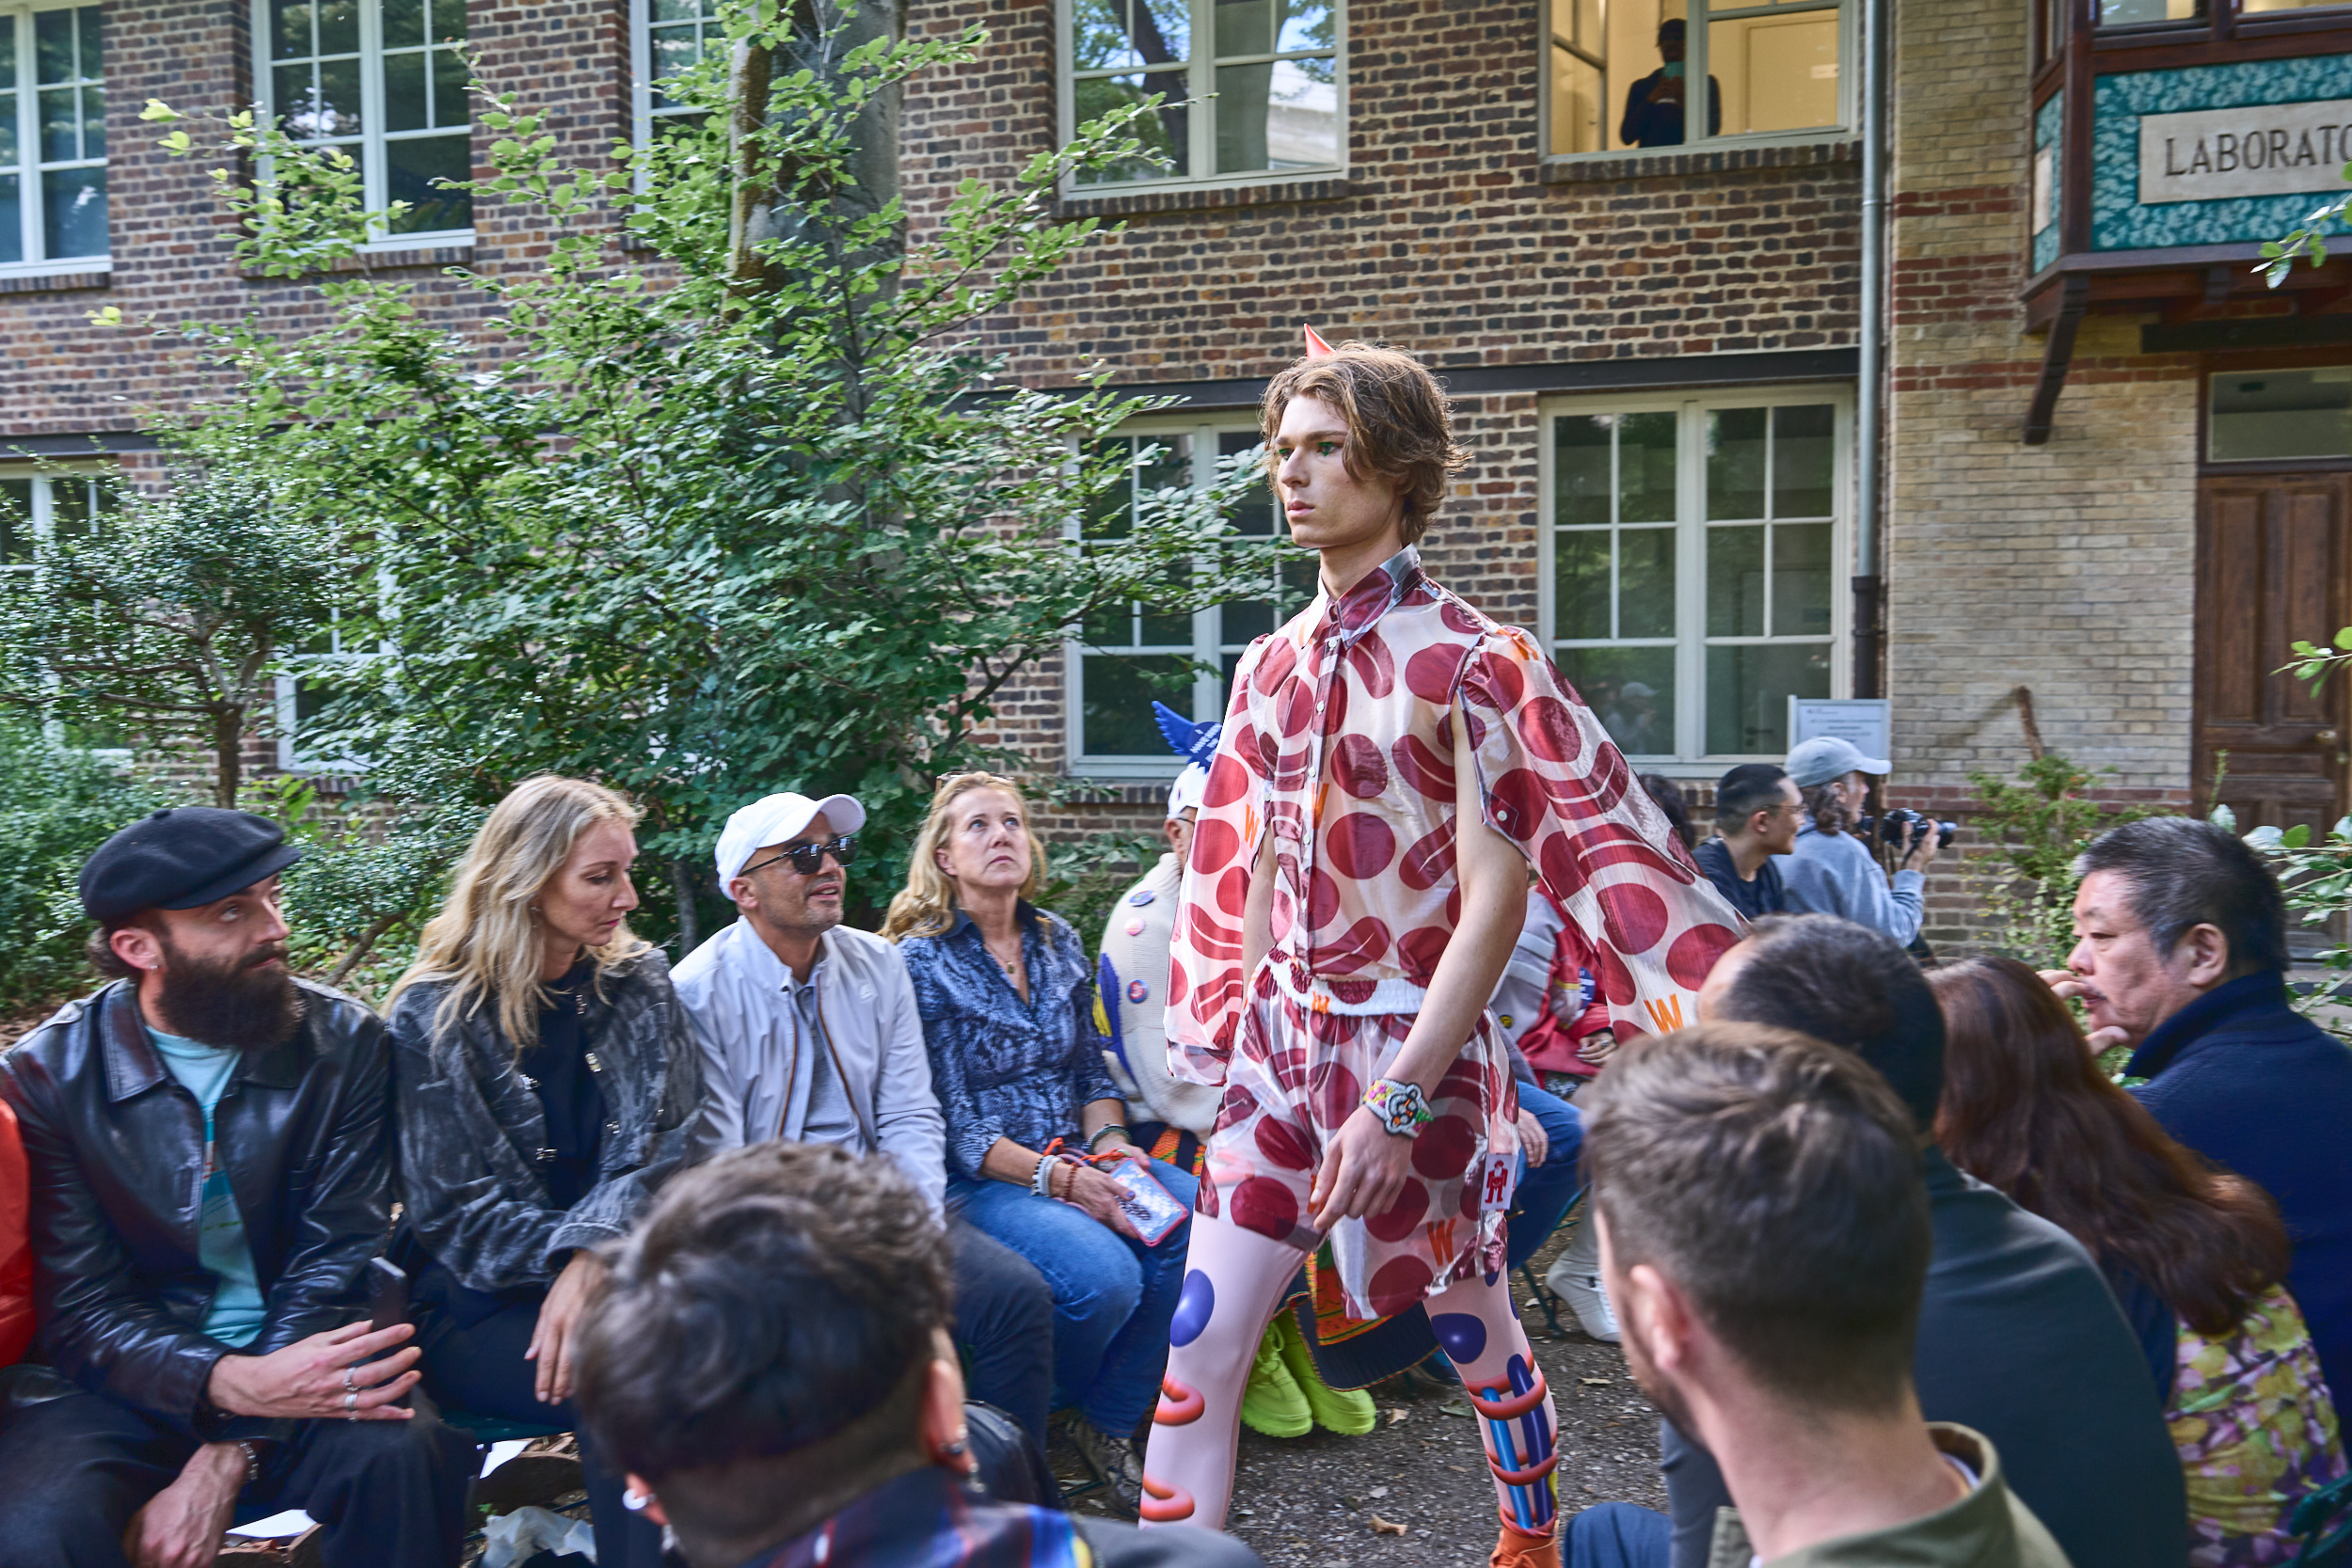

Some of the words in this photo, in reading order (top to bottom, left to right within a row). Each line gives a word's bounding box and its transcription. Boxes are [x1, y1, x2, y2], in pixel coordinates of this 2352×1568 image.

[1245, 803, 1261, 849] W
[1644, 993, 1684, 1035] W
[1426, 1217, 1456, 1266] W
